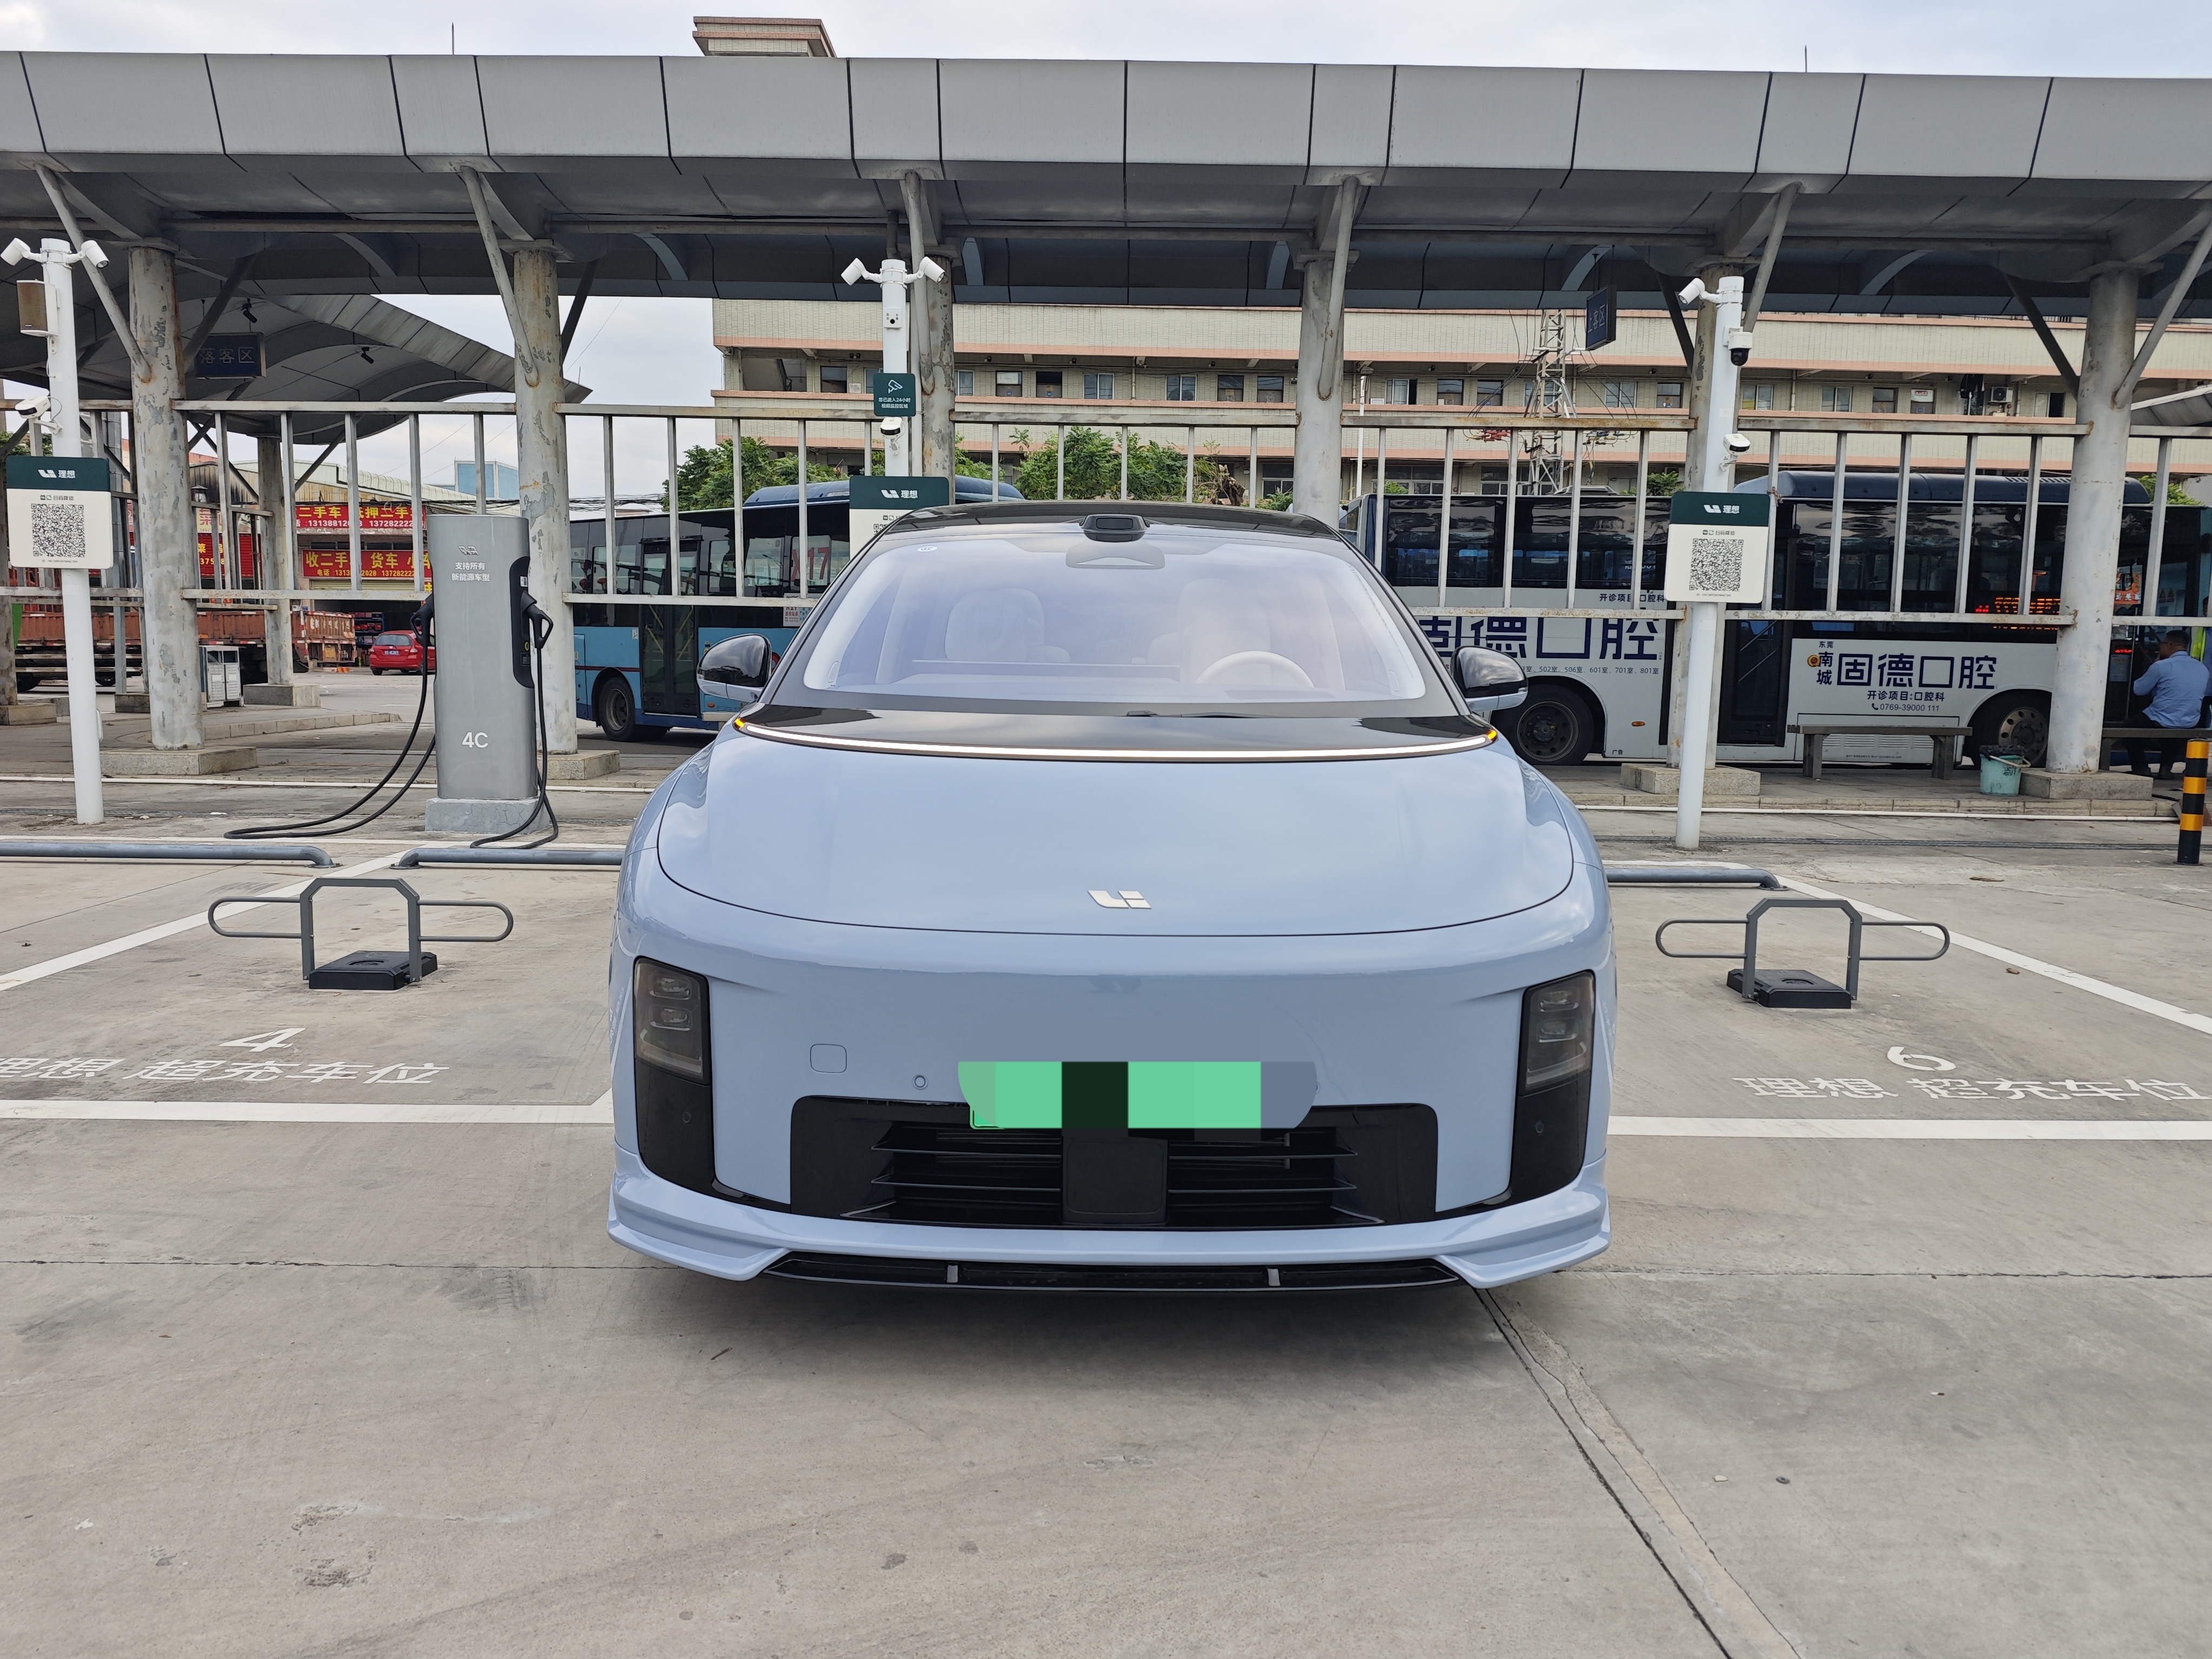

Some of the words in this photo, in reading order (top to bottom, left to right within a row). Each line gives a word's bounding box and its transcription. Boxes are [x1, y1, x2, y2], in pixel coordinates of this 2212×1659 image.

[1588, 304, 1606, 333] 上客区
[200, 347, 254, 364] 落客区
[58, 470, 76, 478] 理想
[901, 490, 918, 498] 理想
[295, 507, 342, 518] 二手车
[1723, 505, 1740, 514] 理想
[306, 551, 362, 568] 收二手
[455, 562, 485, 570] 支持所有
[451, 573, 490, 582] 新能源车型
[1600, 594, 1665, 602] 开诊项目口腔科
[1817, 651, 1834, 685] 南城
[1837, 653, 1997, 689] 固德口腔
[462, 732, 488, 748] 4C
[218, 1028, 306, 1053] 4
[1887, 1047, 1957, 1071] 6
[1731, 1077, 1899, 1099] 理想
